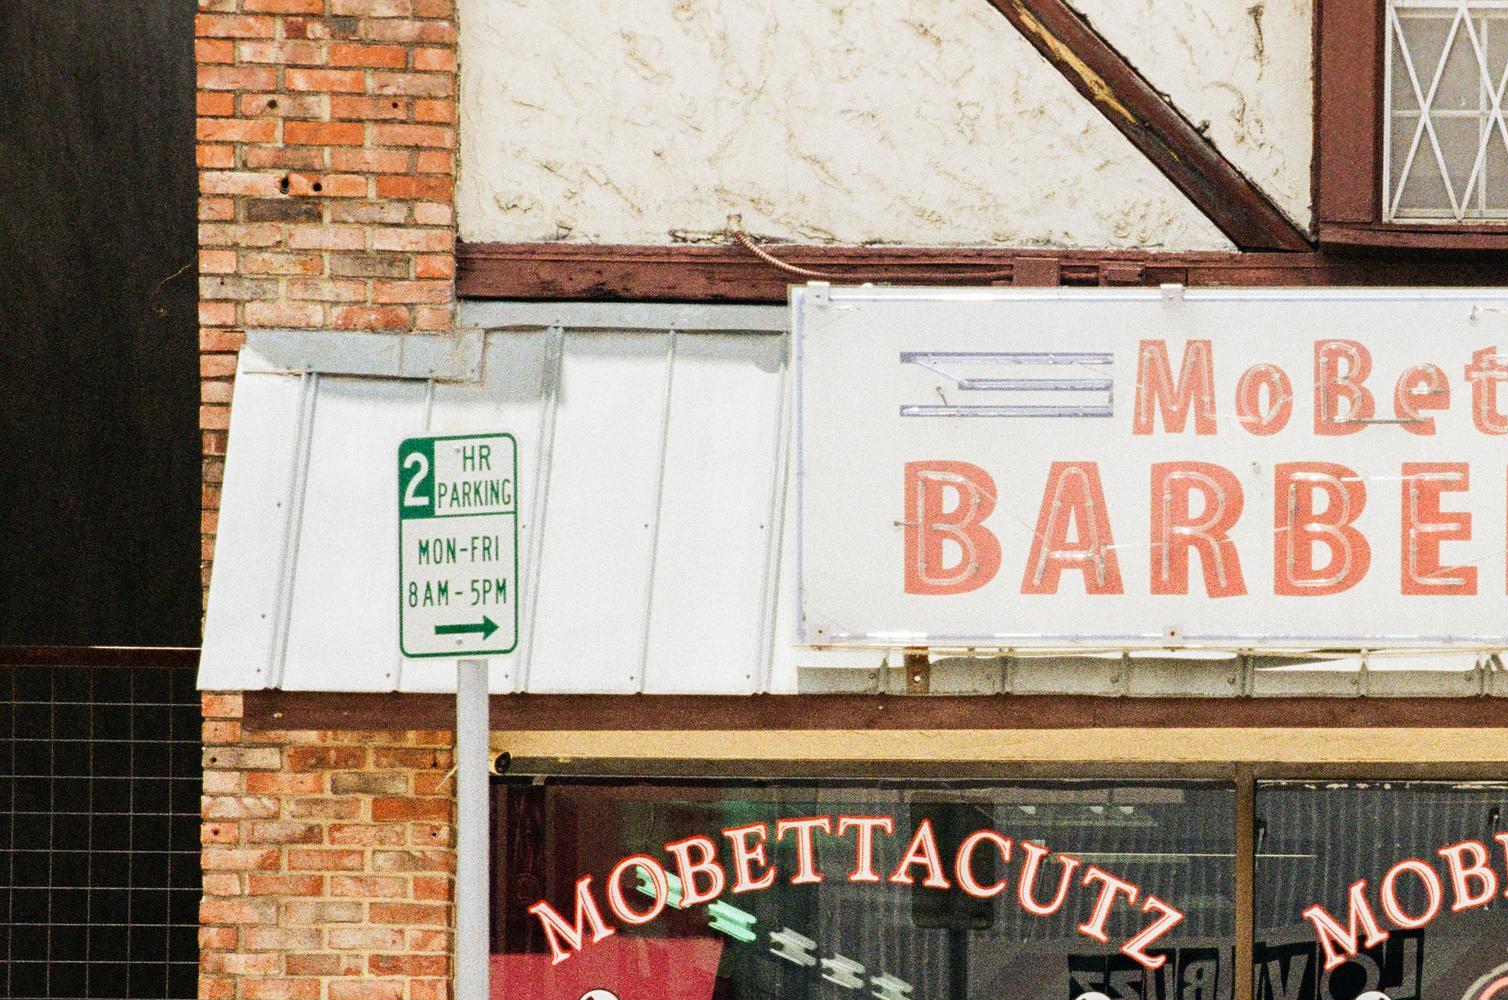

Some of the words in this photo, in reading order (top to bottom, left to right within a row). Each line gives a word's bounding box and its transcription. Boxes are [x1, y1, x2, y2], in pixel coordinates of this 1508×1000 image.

[403, 452, 429, 506] 2
[462, 445, 492, 472] HR
[438, 479, 511, 509] PARKING
[418, 535, 499, 565] MON-FRI
[529, 815, 1185, 969] MOBETTACUTZ
